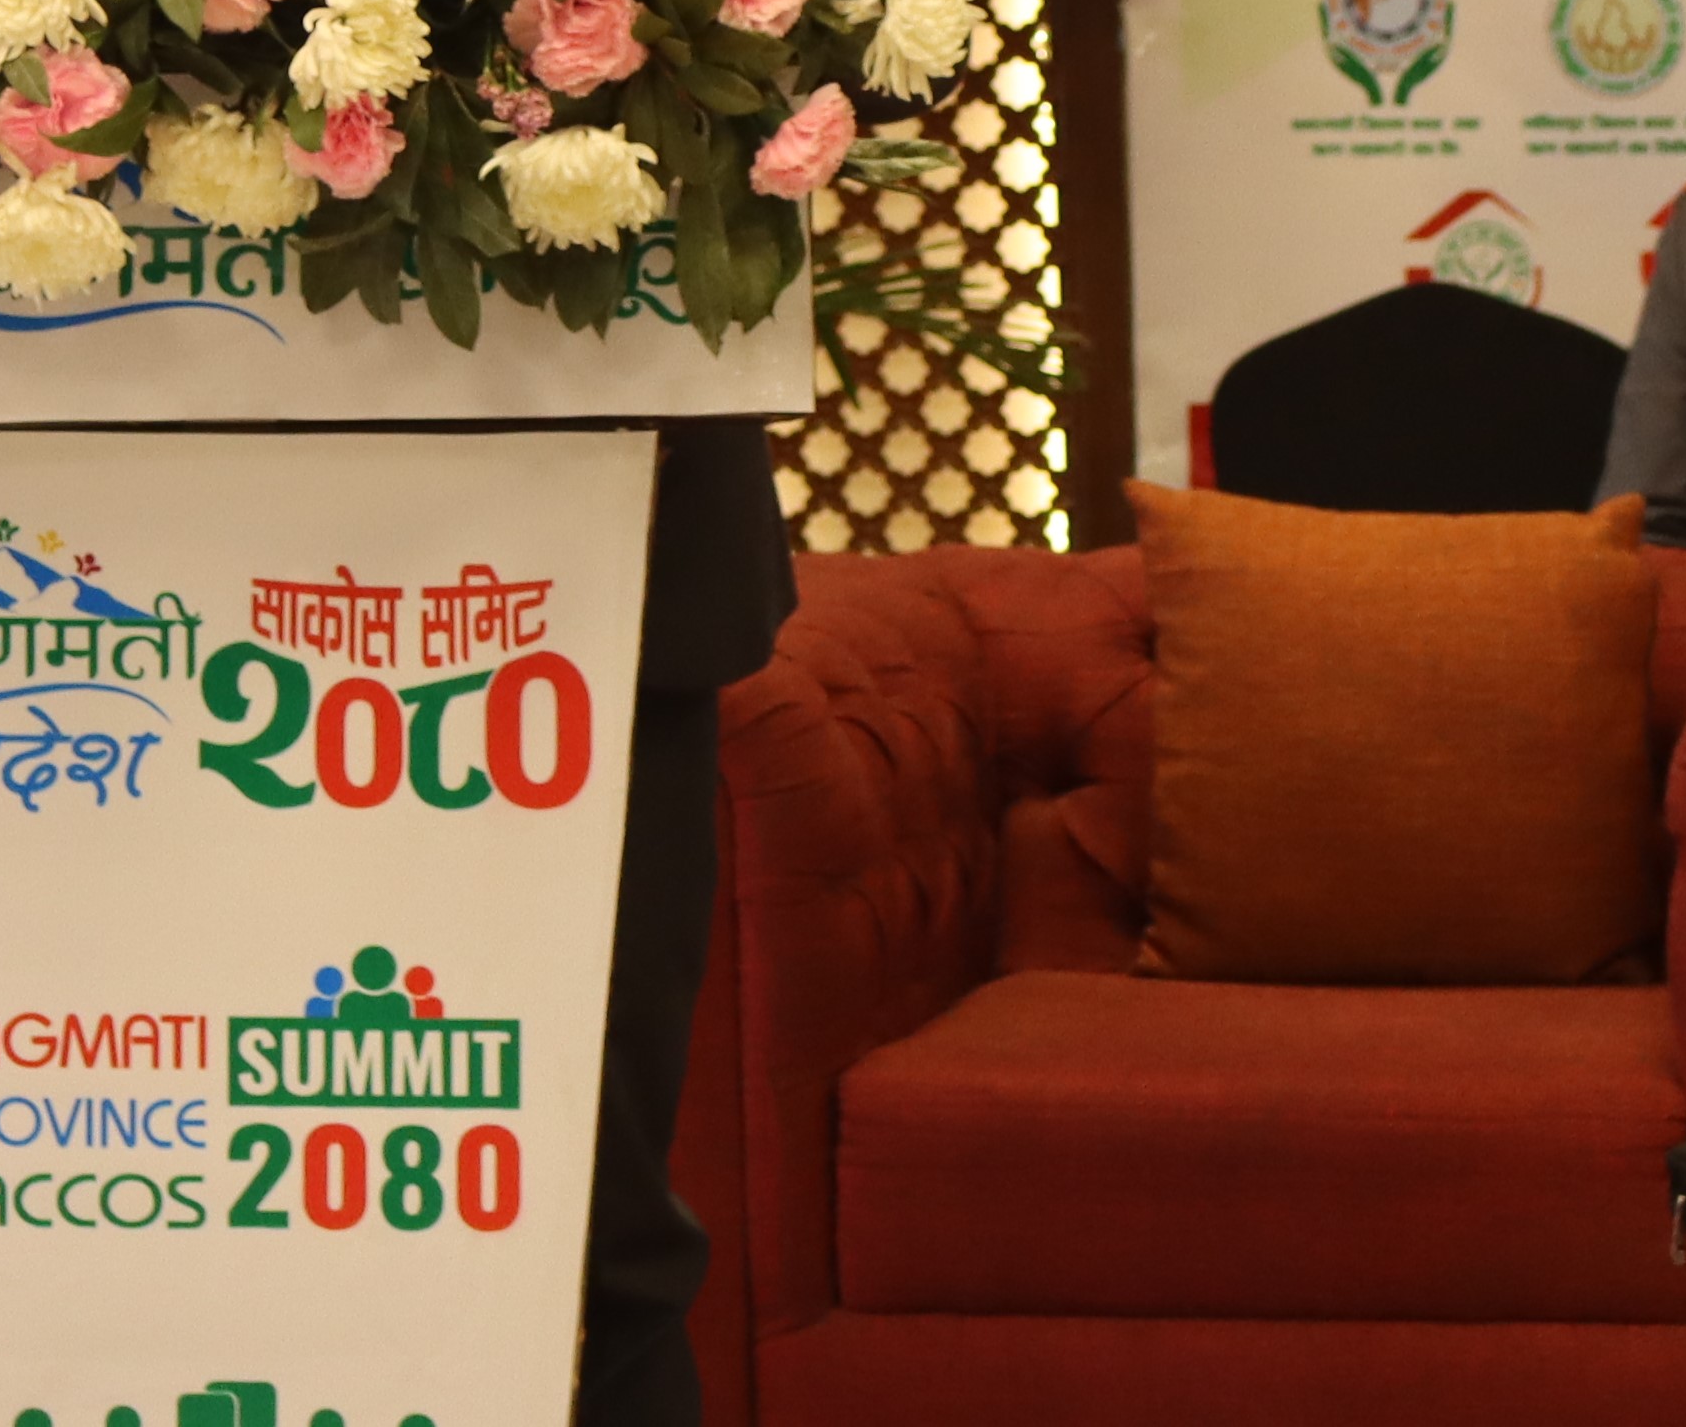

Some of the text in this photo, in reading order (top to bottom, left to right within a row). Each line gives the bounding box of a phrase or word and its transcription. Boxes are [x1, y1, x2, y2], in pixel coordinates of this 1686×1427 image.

[250, 563, 553, 668] साकोस समिट
[198, 640, 593, 810] २०८०
[236, 1028, 512, 1098] SUMMIT
[227, 1122, 521, 1232] 2080
